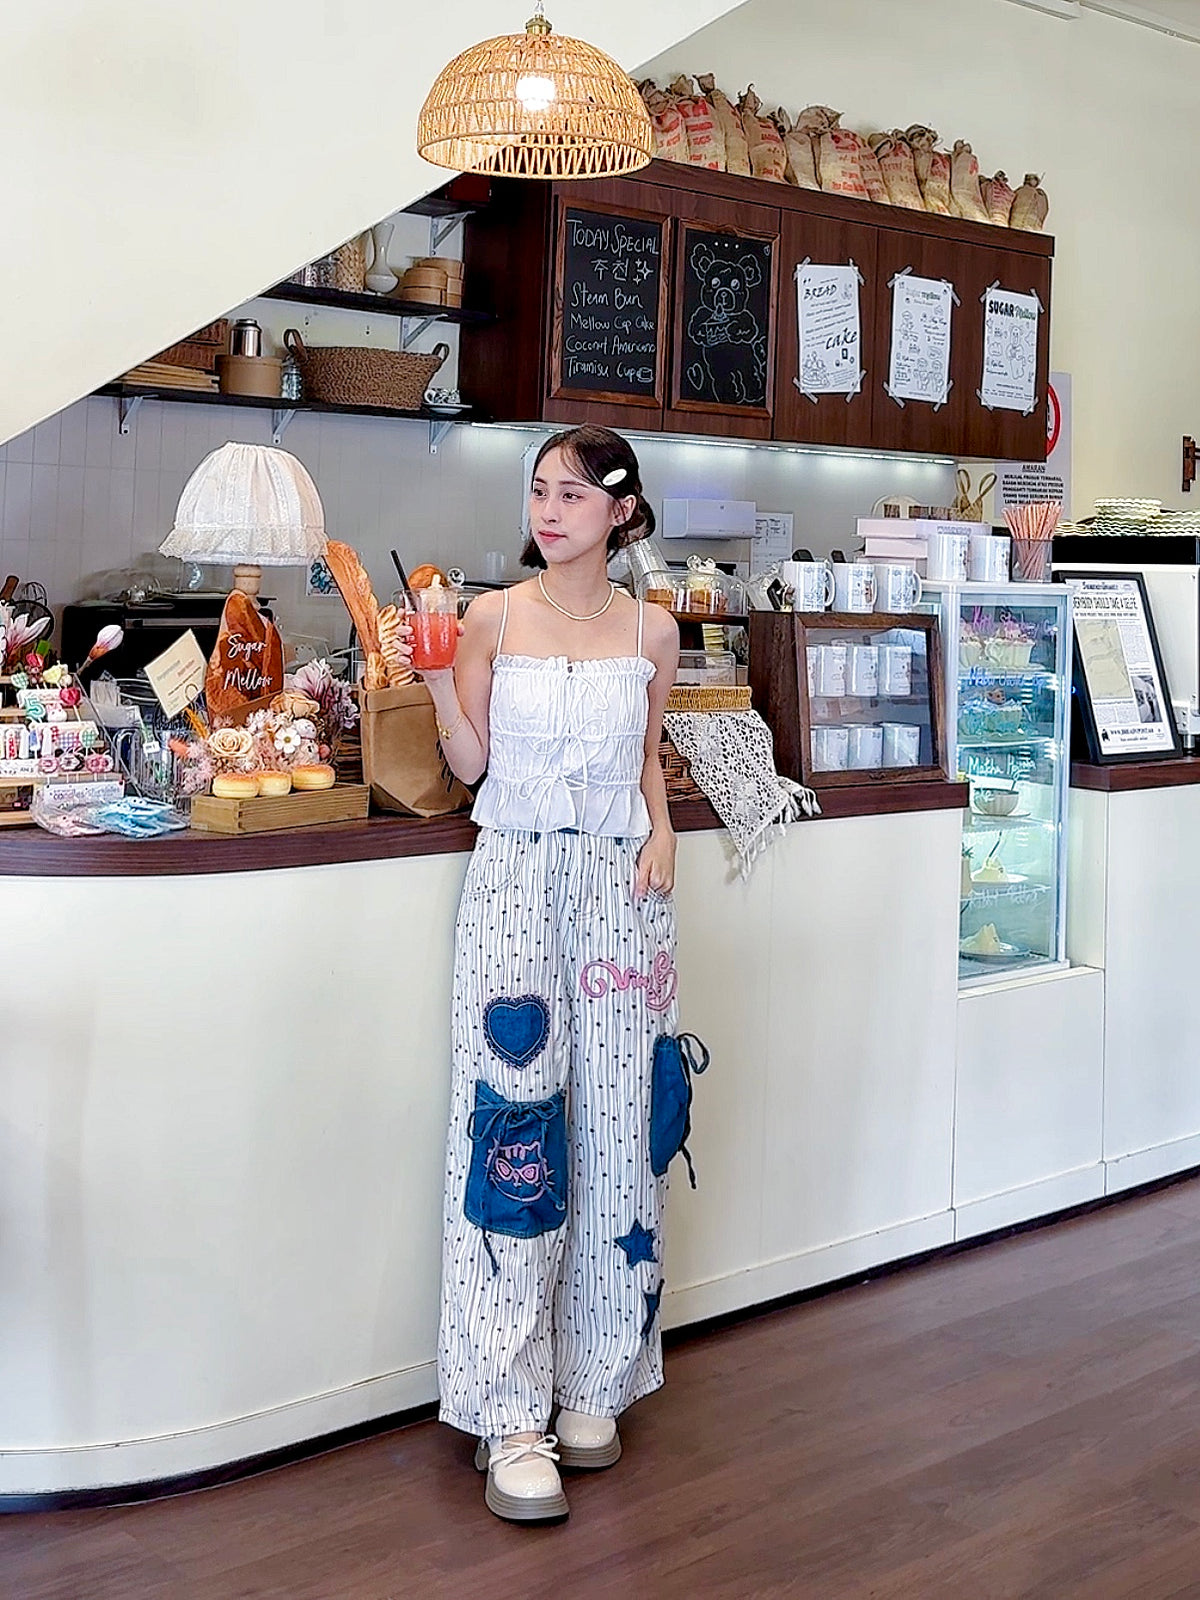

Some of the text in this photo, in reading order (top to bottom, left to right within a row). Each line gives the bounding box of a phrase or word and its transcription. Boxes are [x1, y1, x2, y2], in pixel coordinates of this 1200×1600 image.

[988, 300, 1014, 318] SUGAR
[570, 312, 610, 332] Mellow
[227, 634, 267, 660] Sugar
[223, 667, 273, 691] Mellow
